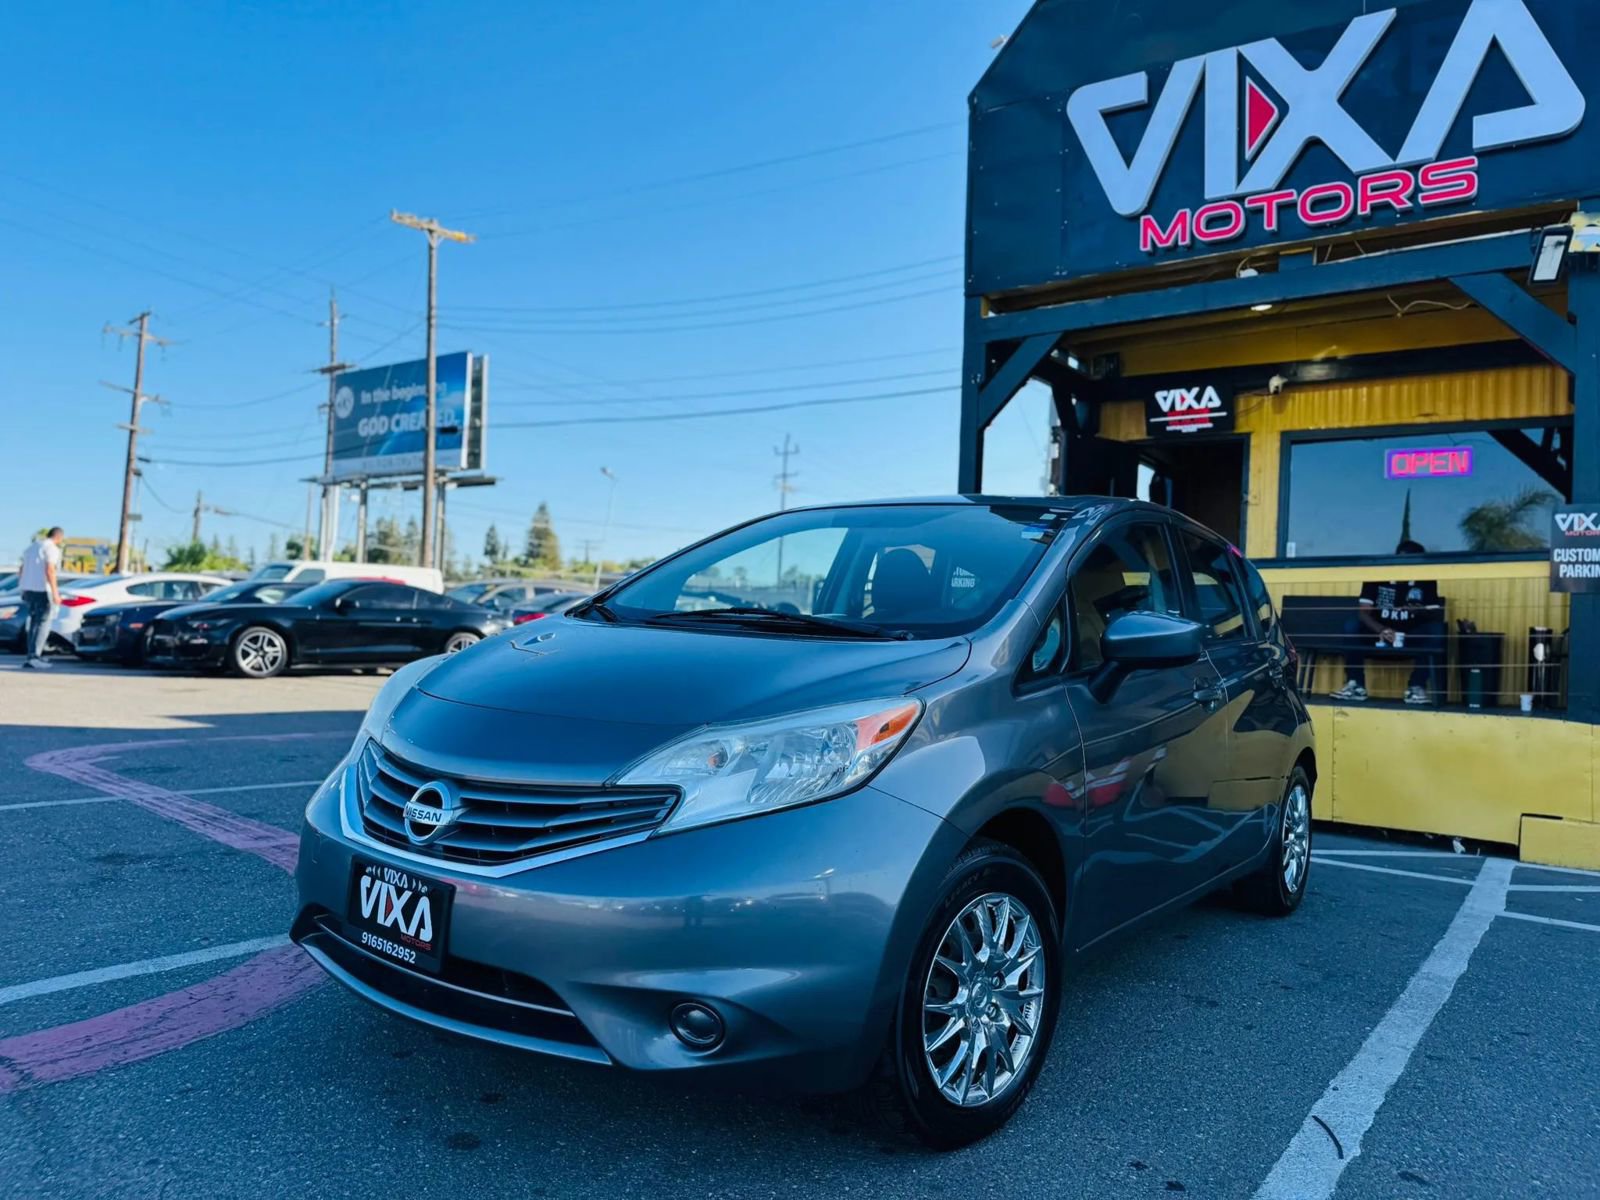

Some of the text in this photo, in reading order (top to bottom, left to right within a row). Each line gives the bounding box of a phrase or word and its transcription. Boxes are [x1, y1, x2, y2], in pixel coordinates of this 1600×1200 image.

[1066, 0, 1586, 217] VIXA
[1139, 156, 1478, 253] MOTORS
[360, 391, 371, 405] In
[373, 388, 391, 403] the
[1154, 385, 1222, 412] VIXA
[357, 408, 460, 438] GOD CREAED.
[1392, 451, 1469, 474] OPEN
[1554, 512, 1600, 532] VIX
[405, 804, 442, 823] NISSAN
[383, 867, 409, 889] VIXA
[360, 875, 433, 942] VIXA
[361, 931, 417, 965] 9165162952
